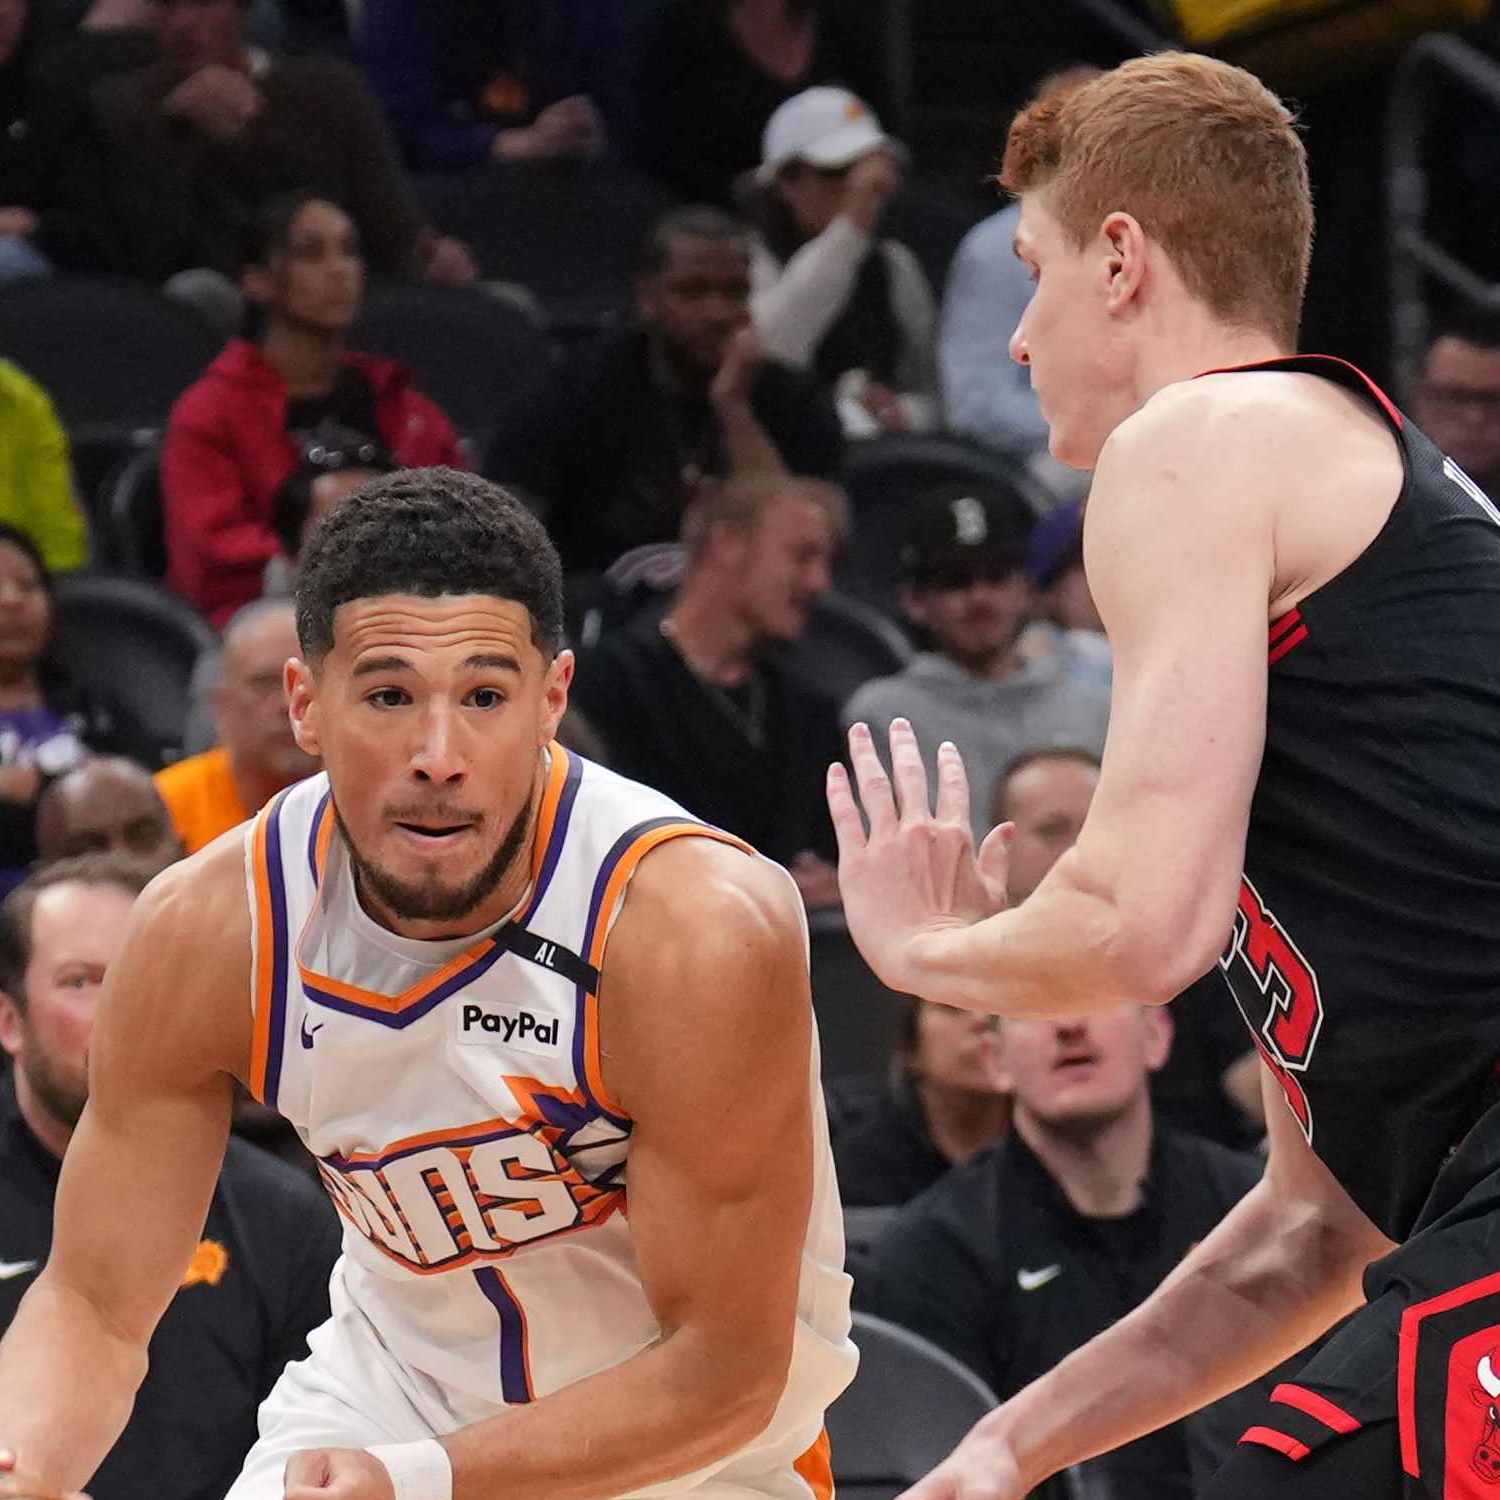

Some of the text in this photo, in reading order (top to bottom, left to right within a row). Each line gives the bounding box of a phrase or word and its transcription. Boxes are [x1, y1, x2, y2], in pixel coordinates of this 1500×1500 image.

[534, 942, 556, 967] AL
[463, 1005, 559, 1045] PayPal
[321, 1132, 583, 1266] UNS
[472, 1265, 537, 1406] 1
